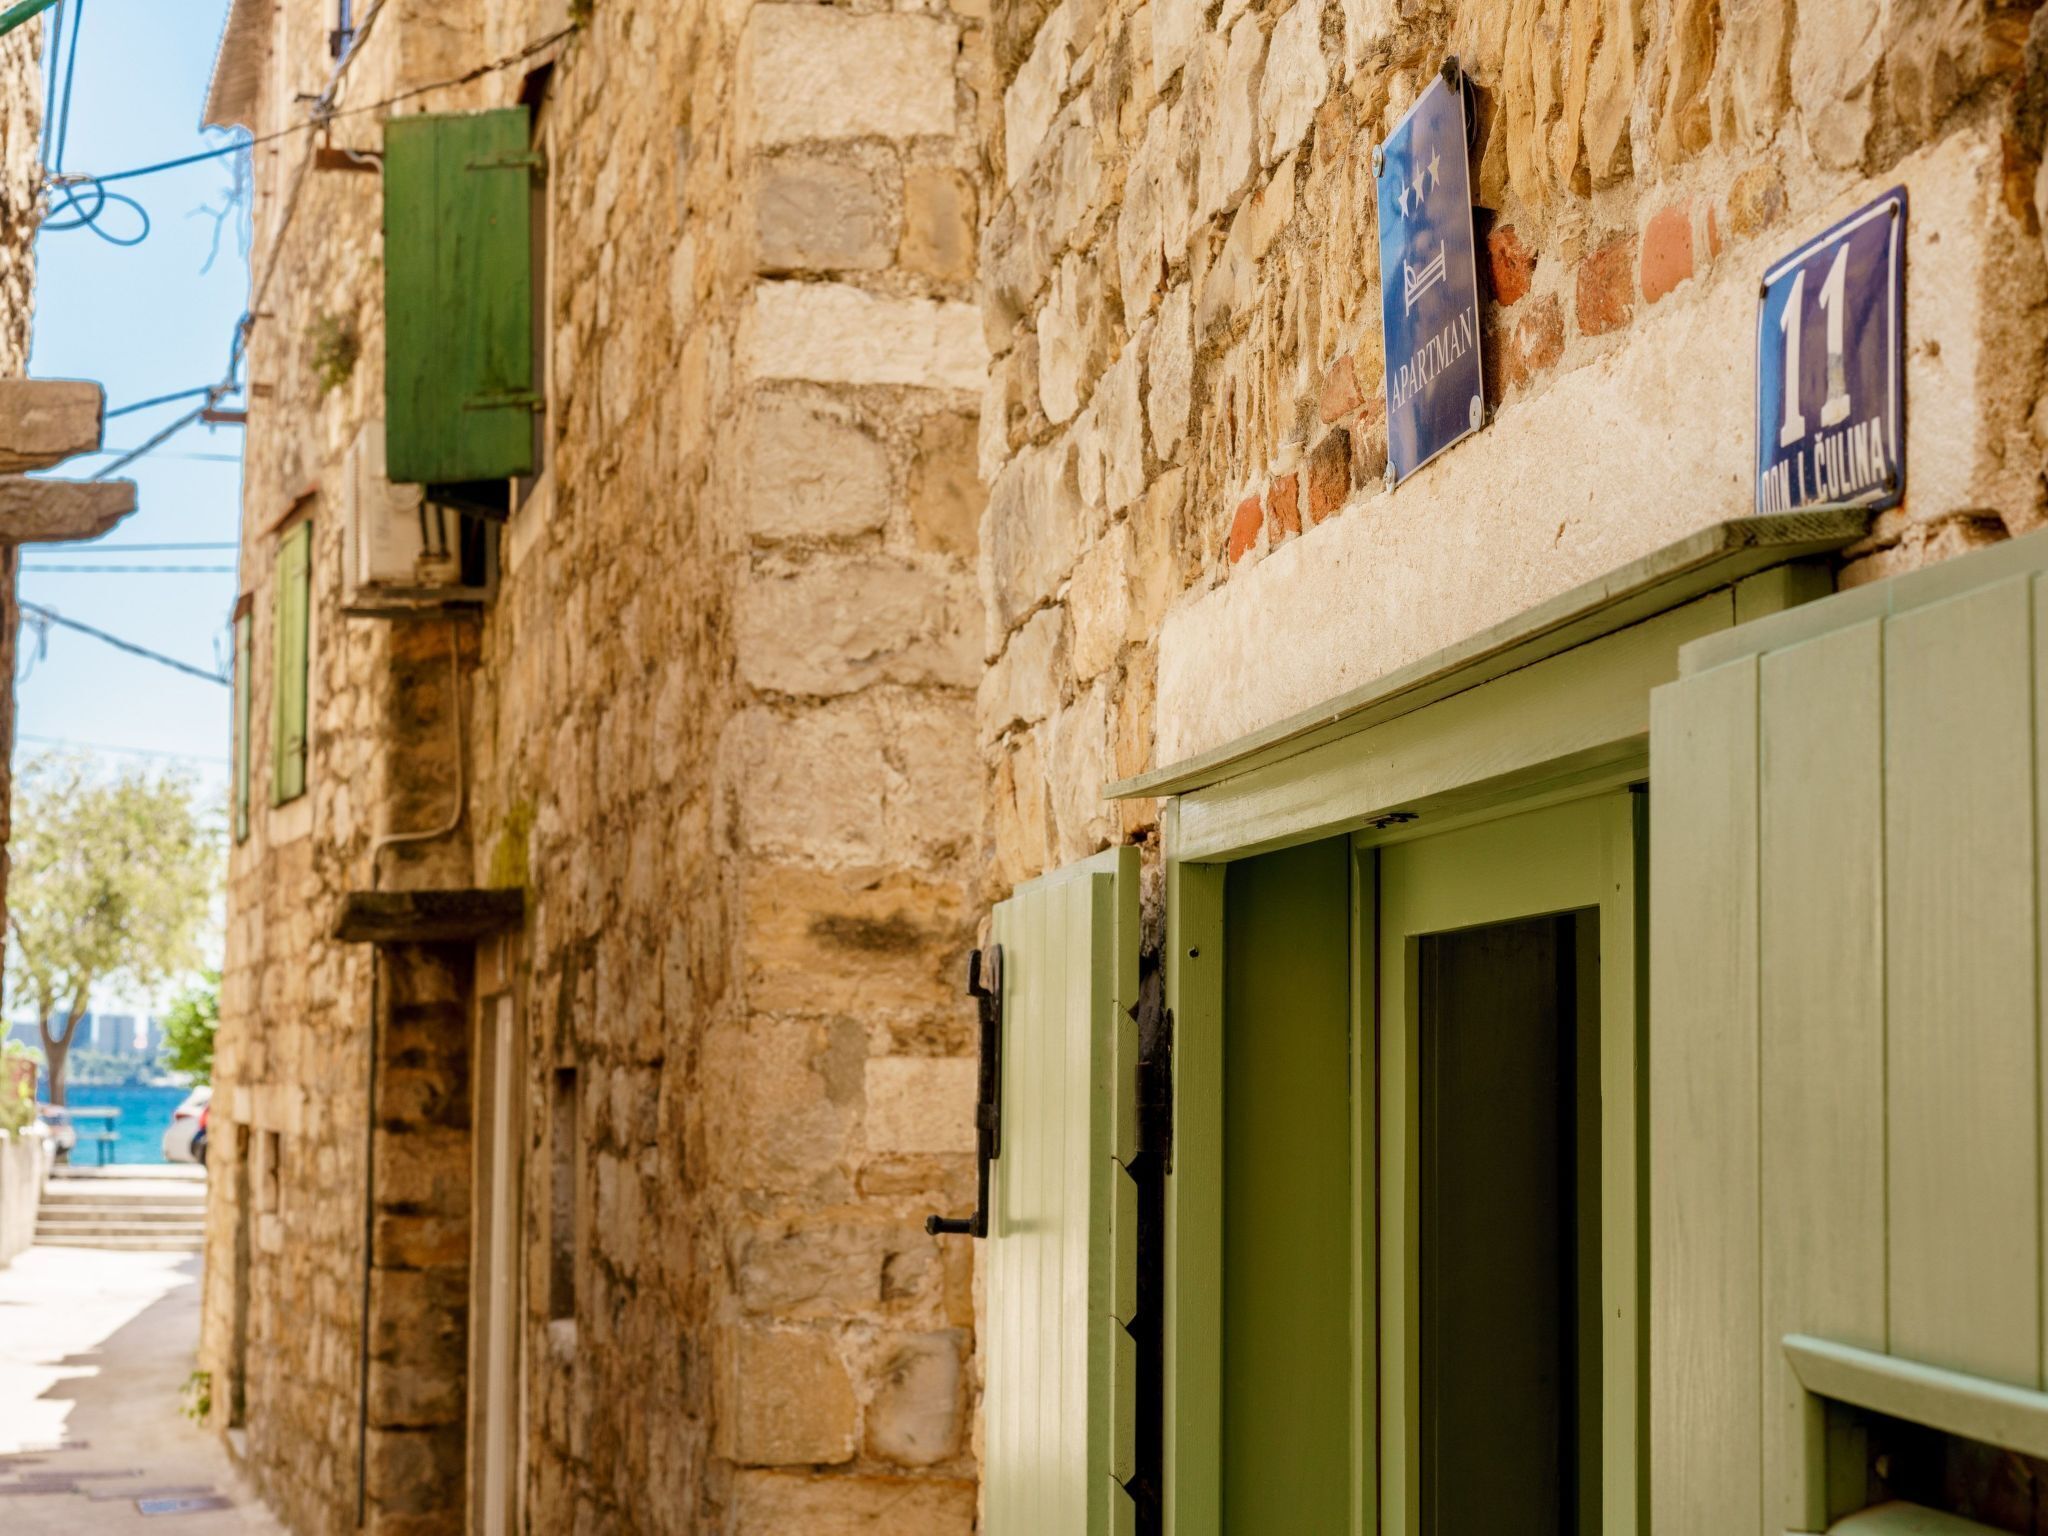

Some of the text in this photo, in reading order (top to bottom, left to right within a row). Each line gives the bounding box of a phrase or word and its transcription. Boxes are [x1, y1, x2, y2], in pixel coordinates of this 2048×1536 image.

[1391, 306, 1472, 414] APARTMAN
[1779, 241, 1851, 448] 11
[1814, 416, 1887, 503] ČULINA
